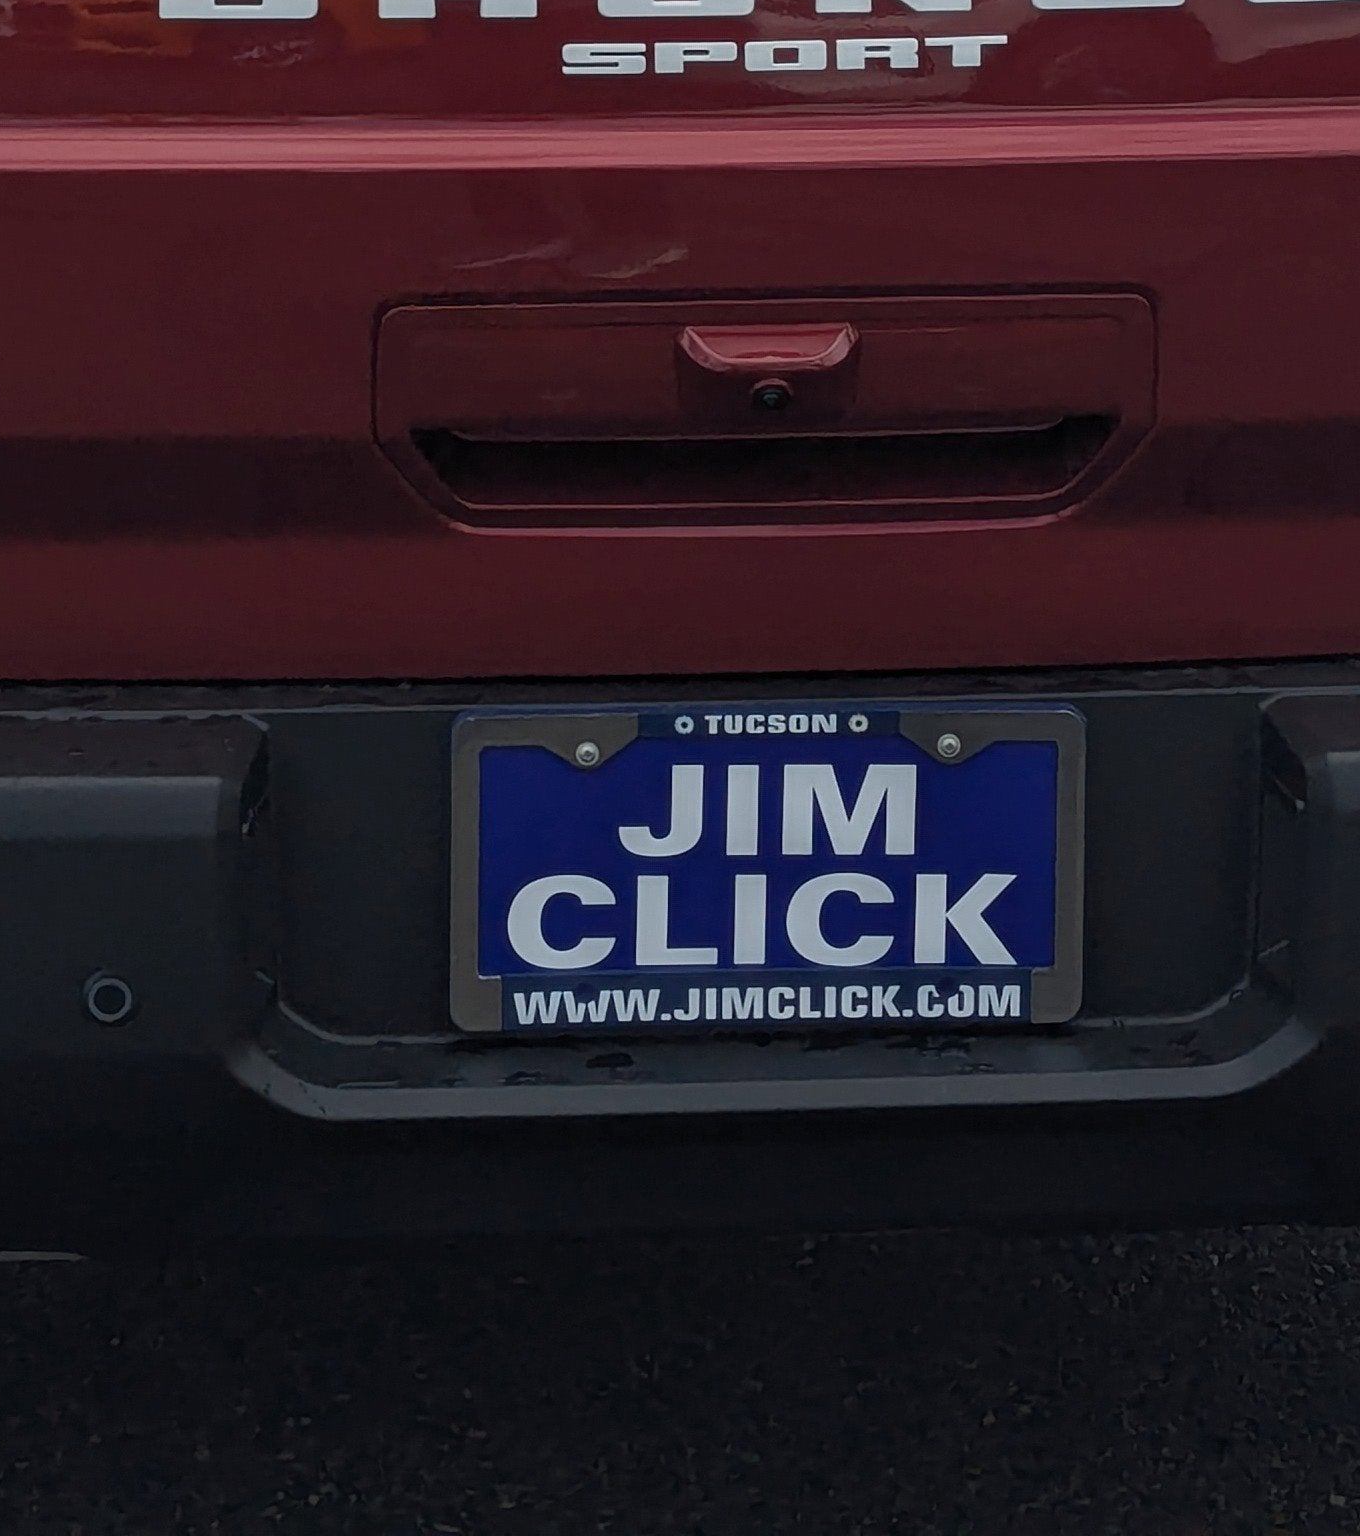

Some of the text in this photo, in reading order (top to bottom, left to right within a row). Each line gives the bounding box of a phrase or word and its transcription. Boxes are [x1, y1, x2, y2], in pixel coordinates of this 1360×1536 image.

[561, 35, 1008, 76] SPORT
[704, 713, 838, 735] TUCSON
[618, 763, 918, 858] JIM
[506, 872, 1019, 970] CLICK
[513, 983, 1022, 1025] WWW.JIMCLICK.COM
